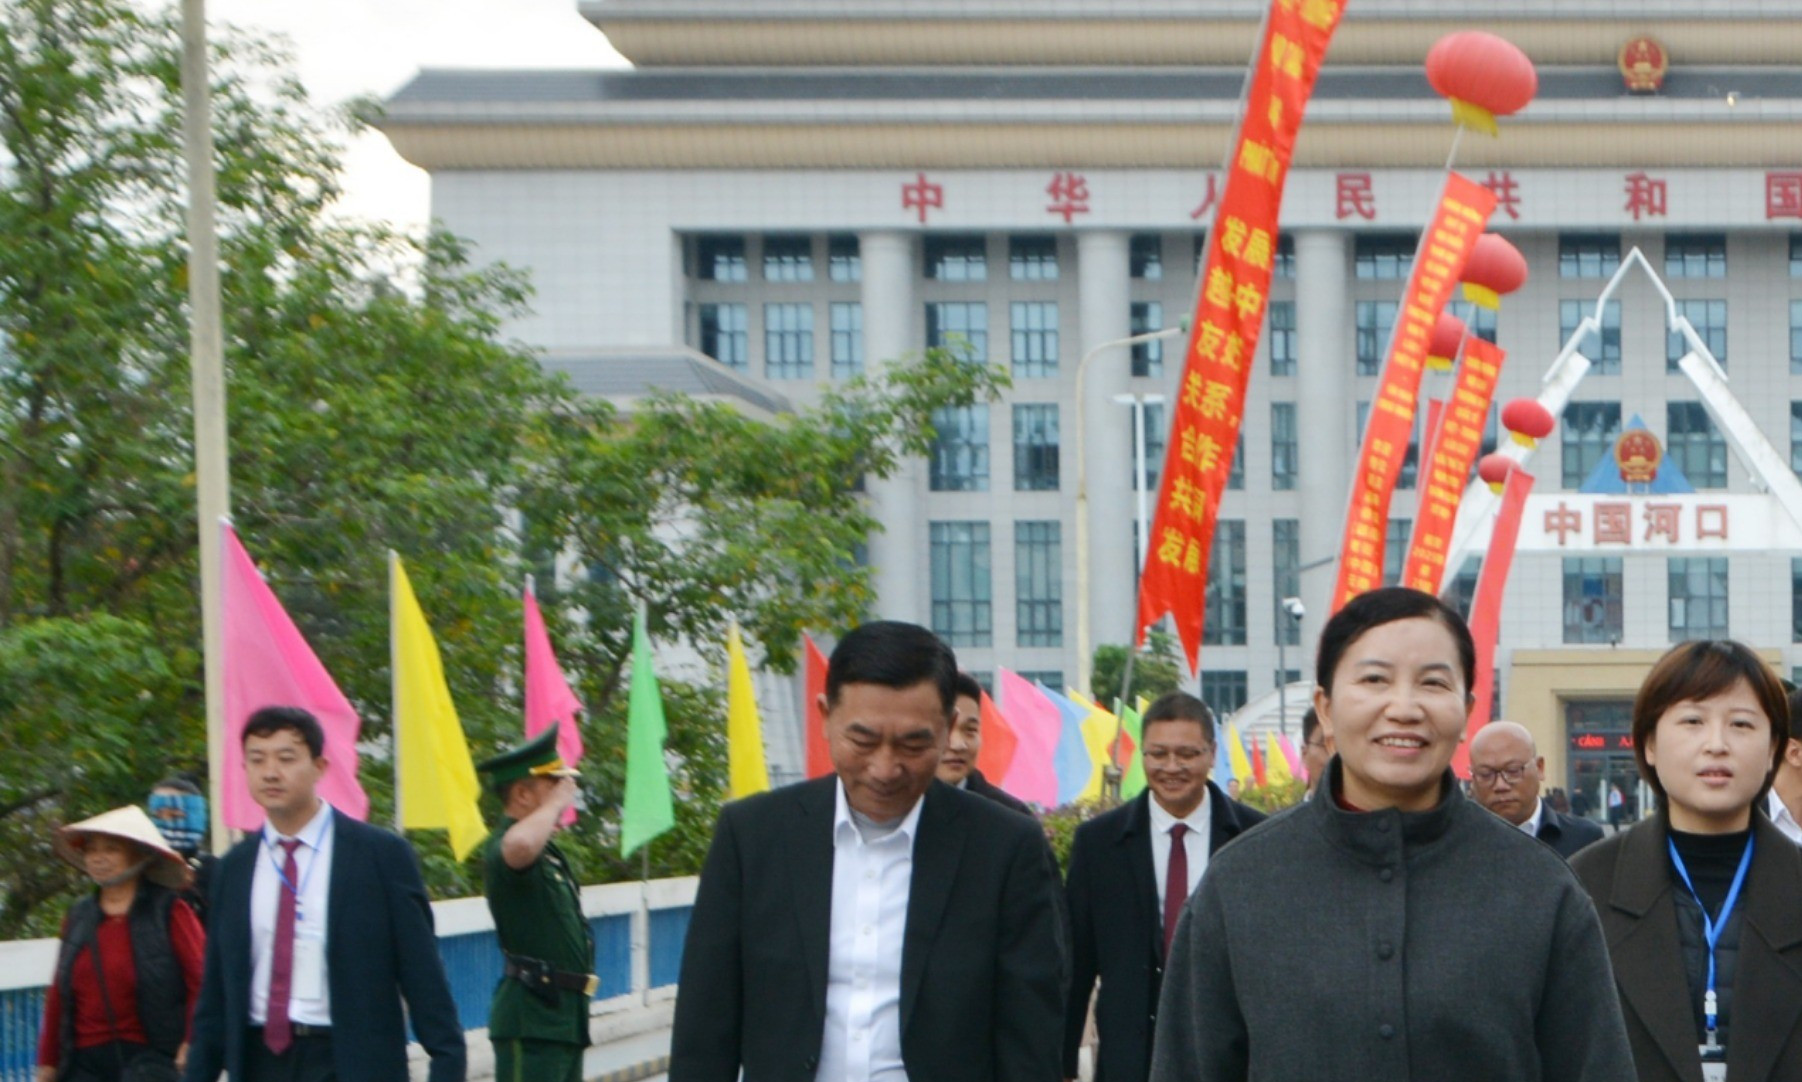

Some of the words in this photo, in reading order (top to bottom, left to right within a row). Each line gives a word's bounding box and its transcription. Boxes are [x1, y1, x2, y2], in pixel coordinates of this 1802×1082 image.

[1221, 215, 1272, 270] 发展
[1544, 501, 1728, 546] 中国河口
